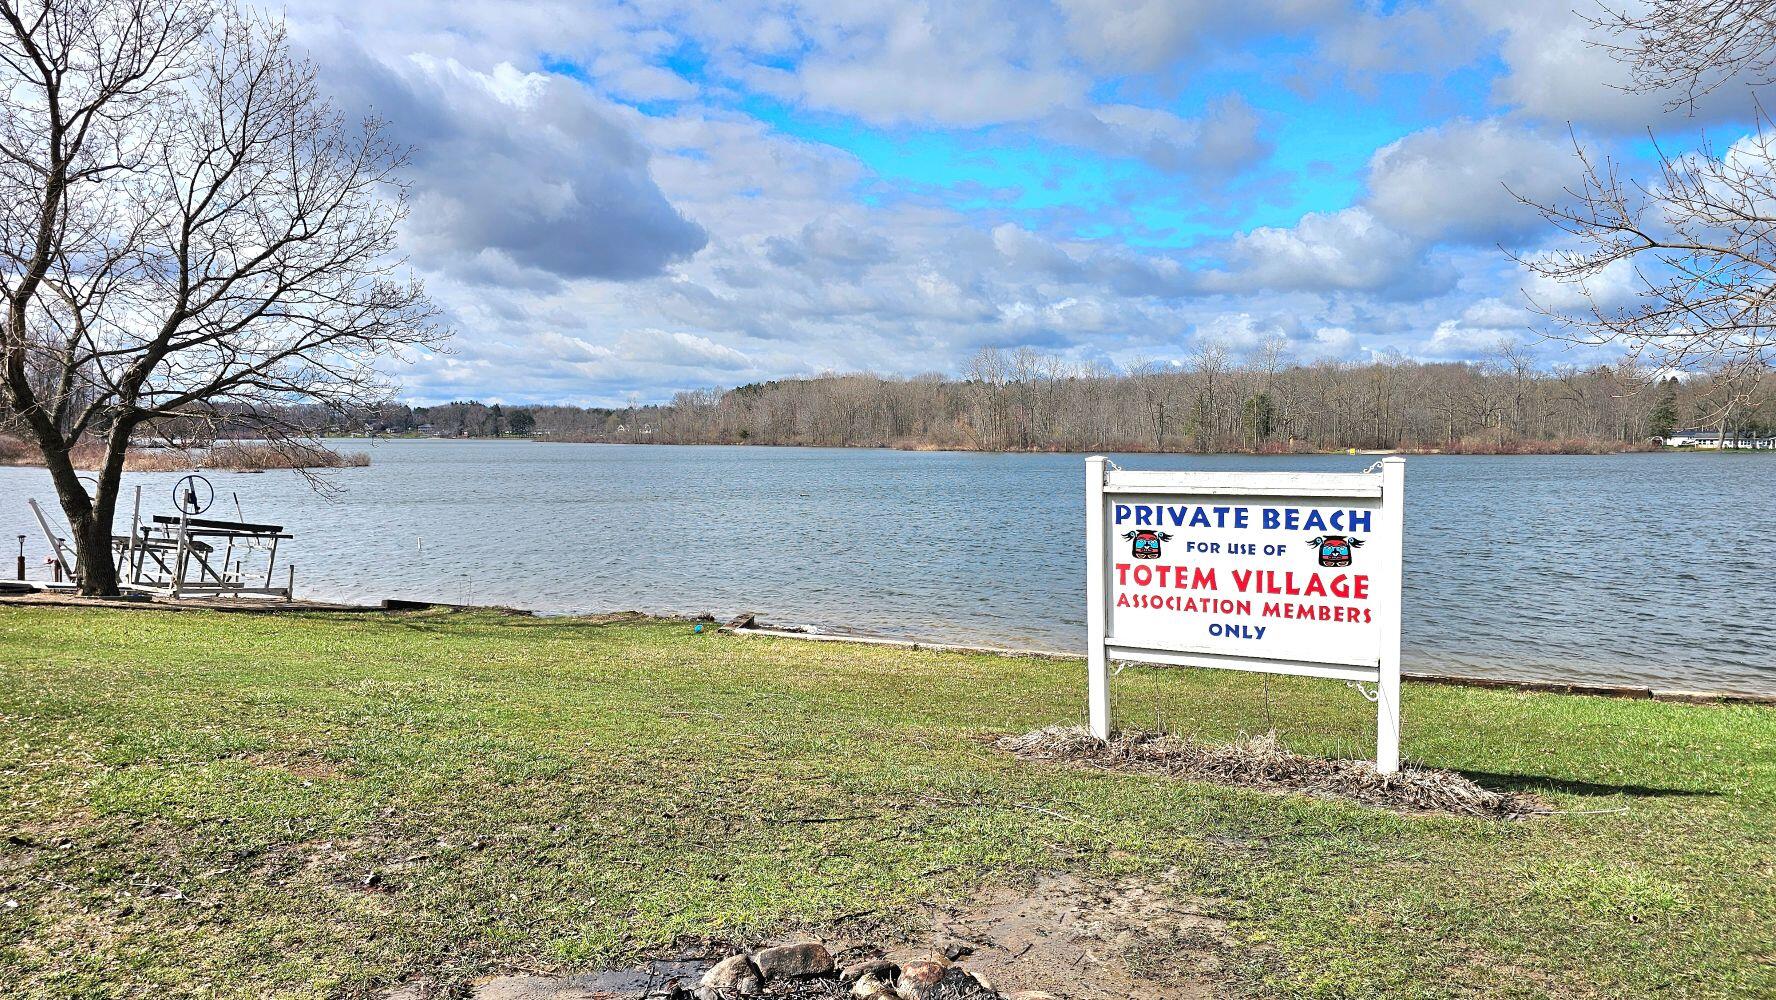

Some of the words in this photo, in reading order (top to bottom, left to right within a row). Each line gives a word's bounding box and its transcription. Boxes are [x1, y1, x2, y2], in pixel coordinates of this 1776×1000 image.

[1115, 505, 1248, 529] PRIVATE
[1263, 508, 1371, 532] BEACH
[1186, 541, 1221, 554] FOR
[1227, 543, 1256, 555] USE
[1263, 544, 1287, 557] OF
[1115, 563, 1217, 591] TOTEM
[1232, 569, 1369, 600] VILLAGE
[1117, 593, 1251, 616] ASSOCIATION
[1262, 602, 1372, 624] MEMBERS
[1208, 623, 1266, 640] ONLY
